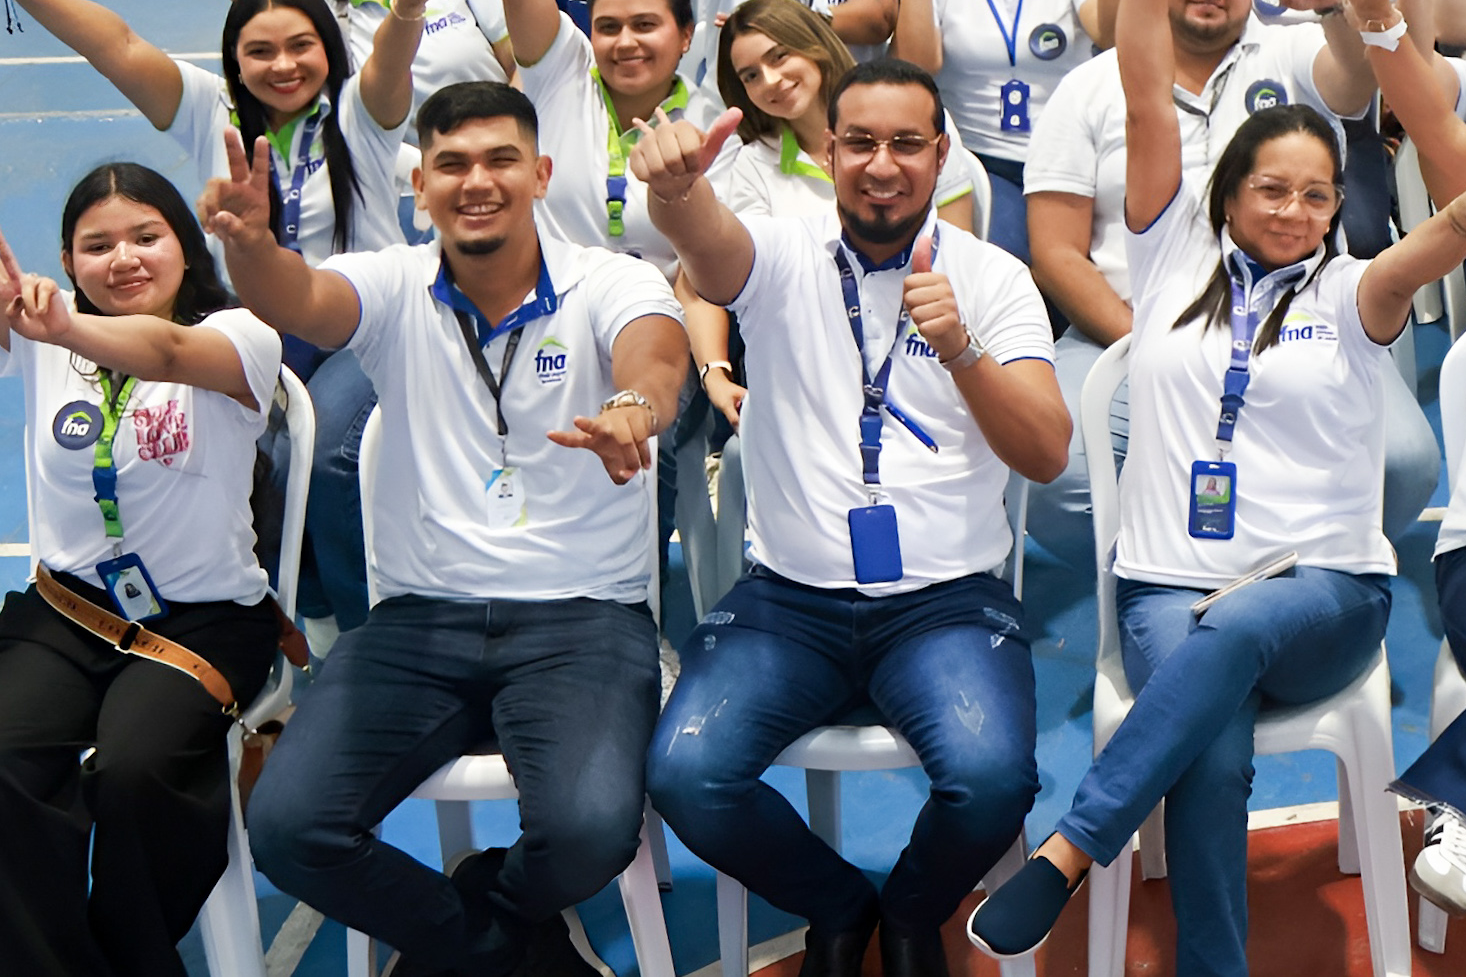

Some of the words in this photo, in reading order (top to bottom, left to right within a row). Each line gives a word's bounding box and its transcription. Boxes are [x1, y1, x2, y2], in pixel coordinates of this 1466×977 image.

[1280, 325, 1313, 343] fna
[535, 349, 567, 373] fna
[61, 419, 90, 436] fna
